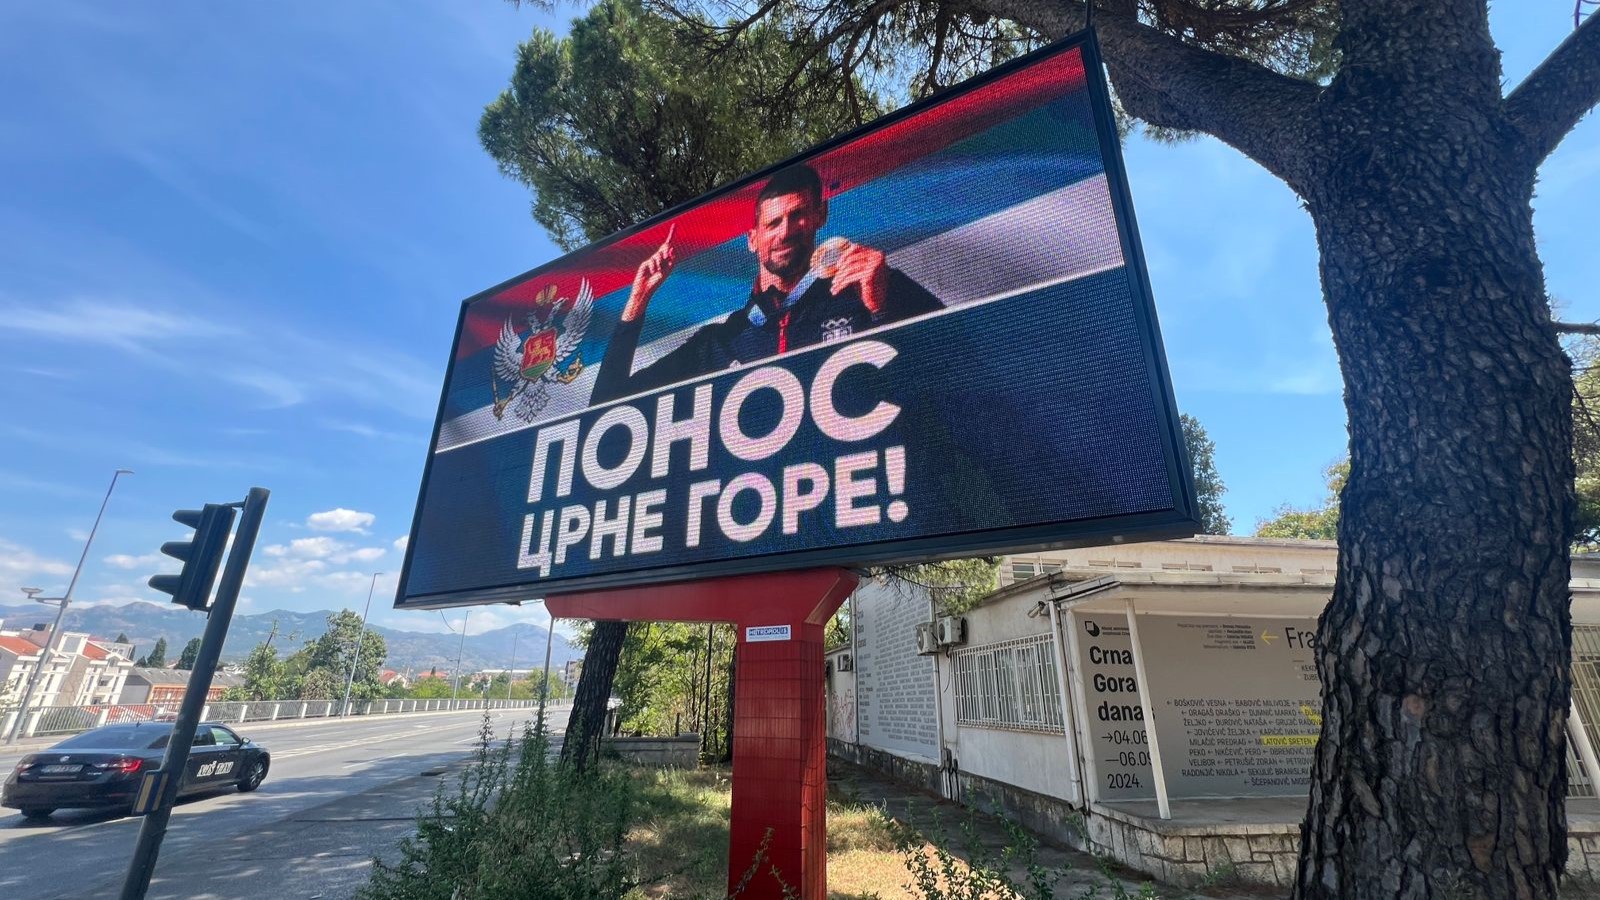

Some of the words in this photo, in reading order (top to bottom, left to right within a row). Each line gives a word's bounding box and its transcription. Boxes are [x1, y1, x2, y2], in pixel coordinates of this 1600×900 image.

[527, 340, 902, 503] ПОНОС
[516, 488, 667, 578] ЦРНЕ
[685, 444, 909, 548] ГОРЕ!
[749, 627, 788, 636] METROPOLIS
[1089, 645, 1133, 665] Crna
[1093, 673, 1137, 692] Gora
[1098, 701, 1155, 721] dana
[1107, 773, 1143, 789] 2024.
